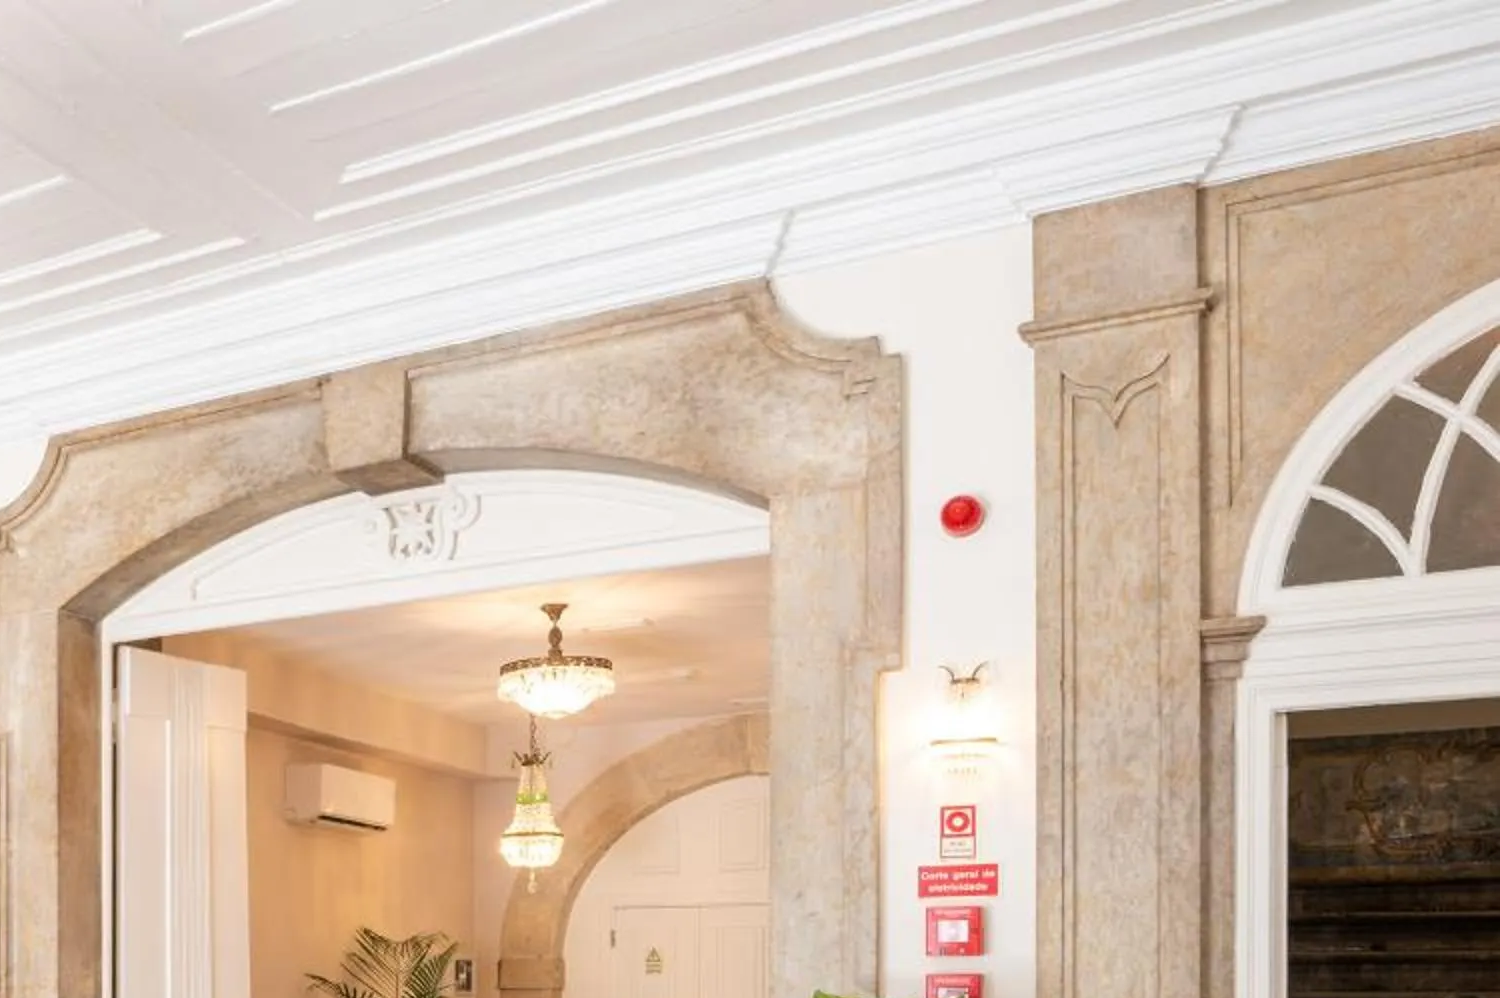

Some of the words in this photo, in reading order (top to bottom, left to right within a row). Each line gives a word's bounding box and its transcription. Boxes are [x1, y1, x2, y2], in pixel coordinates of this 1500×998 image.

[921, 871, 949, 881] Corte
[952, 868, 979, 882] geral
[982, 867, 996, 878] de
